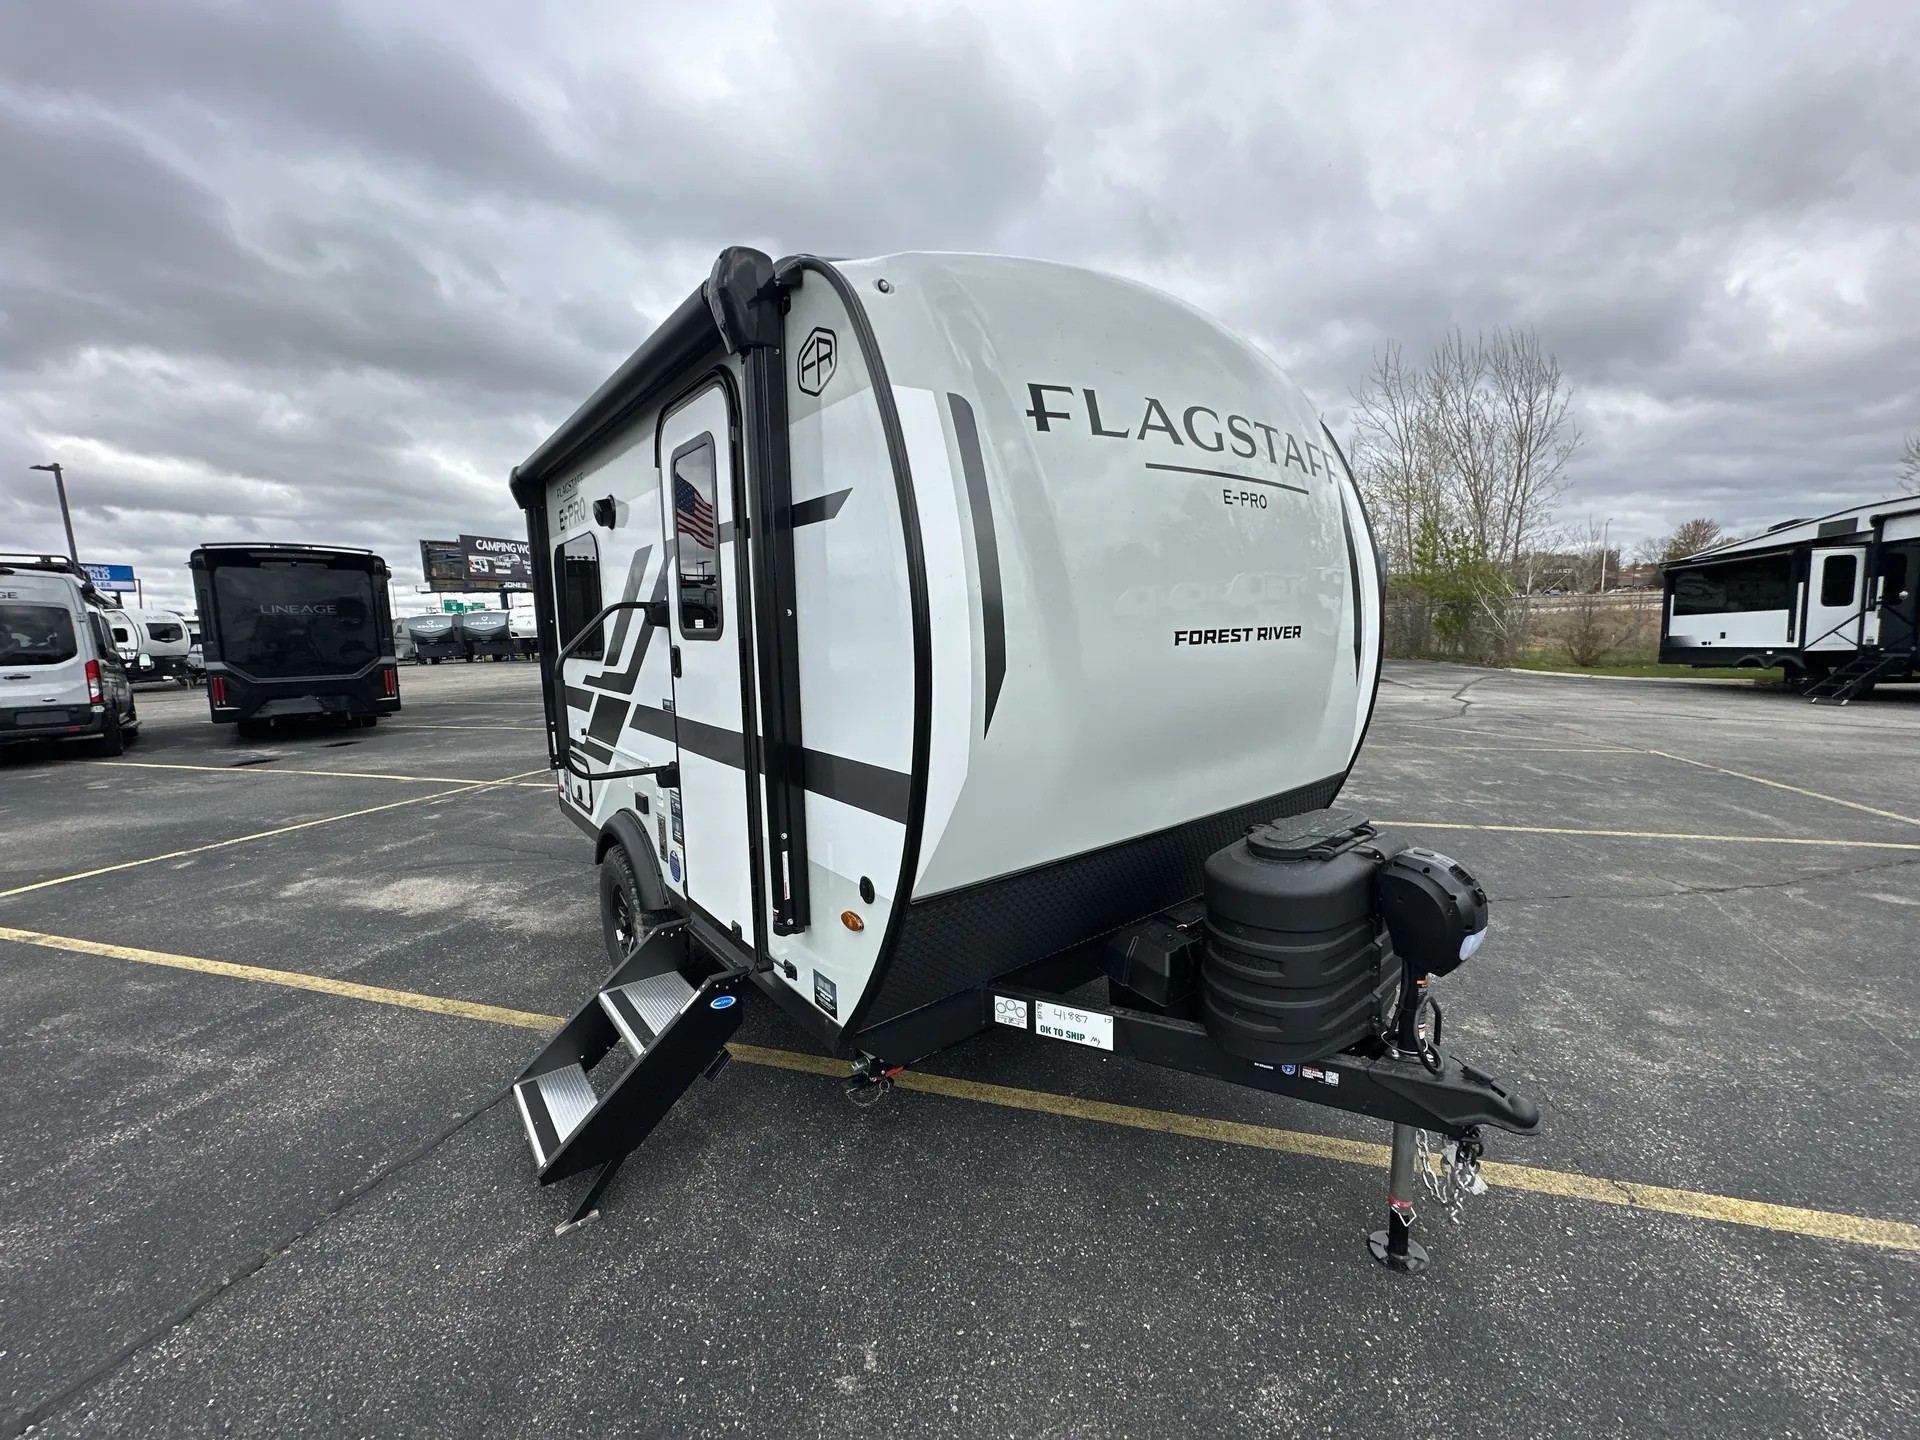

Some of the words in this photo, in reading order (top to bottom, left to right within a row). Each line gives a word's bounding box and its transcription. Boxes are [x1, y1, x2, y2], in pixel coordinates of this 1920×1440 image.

[1026, 383, 1337, 484] FLAGSTAFF
[1223, 489, 1268, 509] E-PRO
[558, 496, 586, 531] E-PRO
[475, 539, 517, 553] CAMPING
[503, 581, 528, 589] JONES
[260, 604, 337, 614] LINEAGE
[1174, 628, 1252, 646] FOREST
[1257, 626, 1302, 641] RIVER
[1040, 1024, 1052, 1034] OK
[1053, 1027, 1064, 1037] TO
[1065, 1030, 1086, 1042] SHIP
